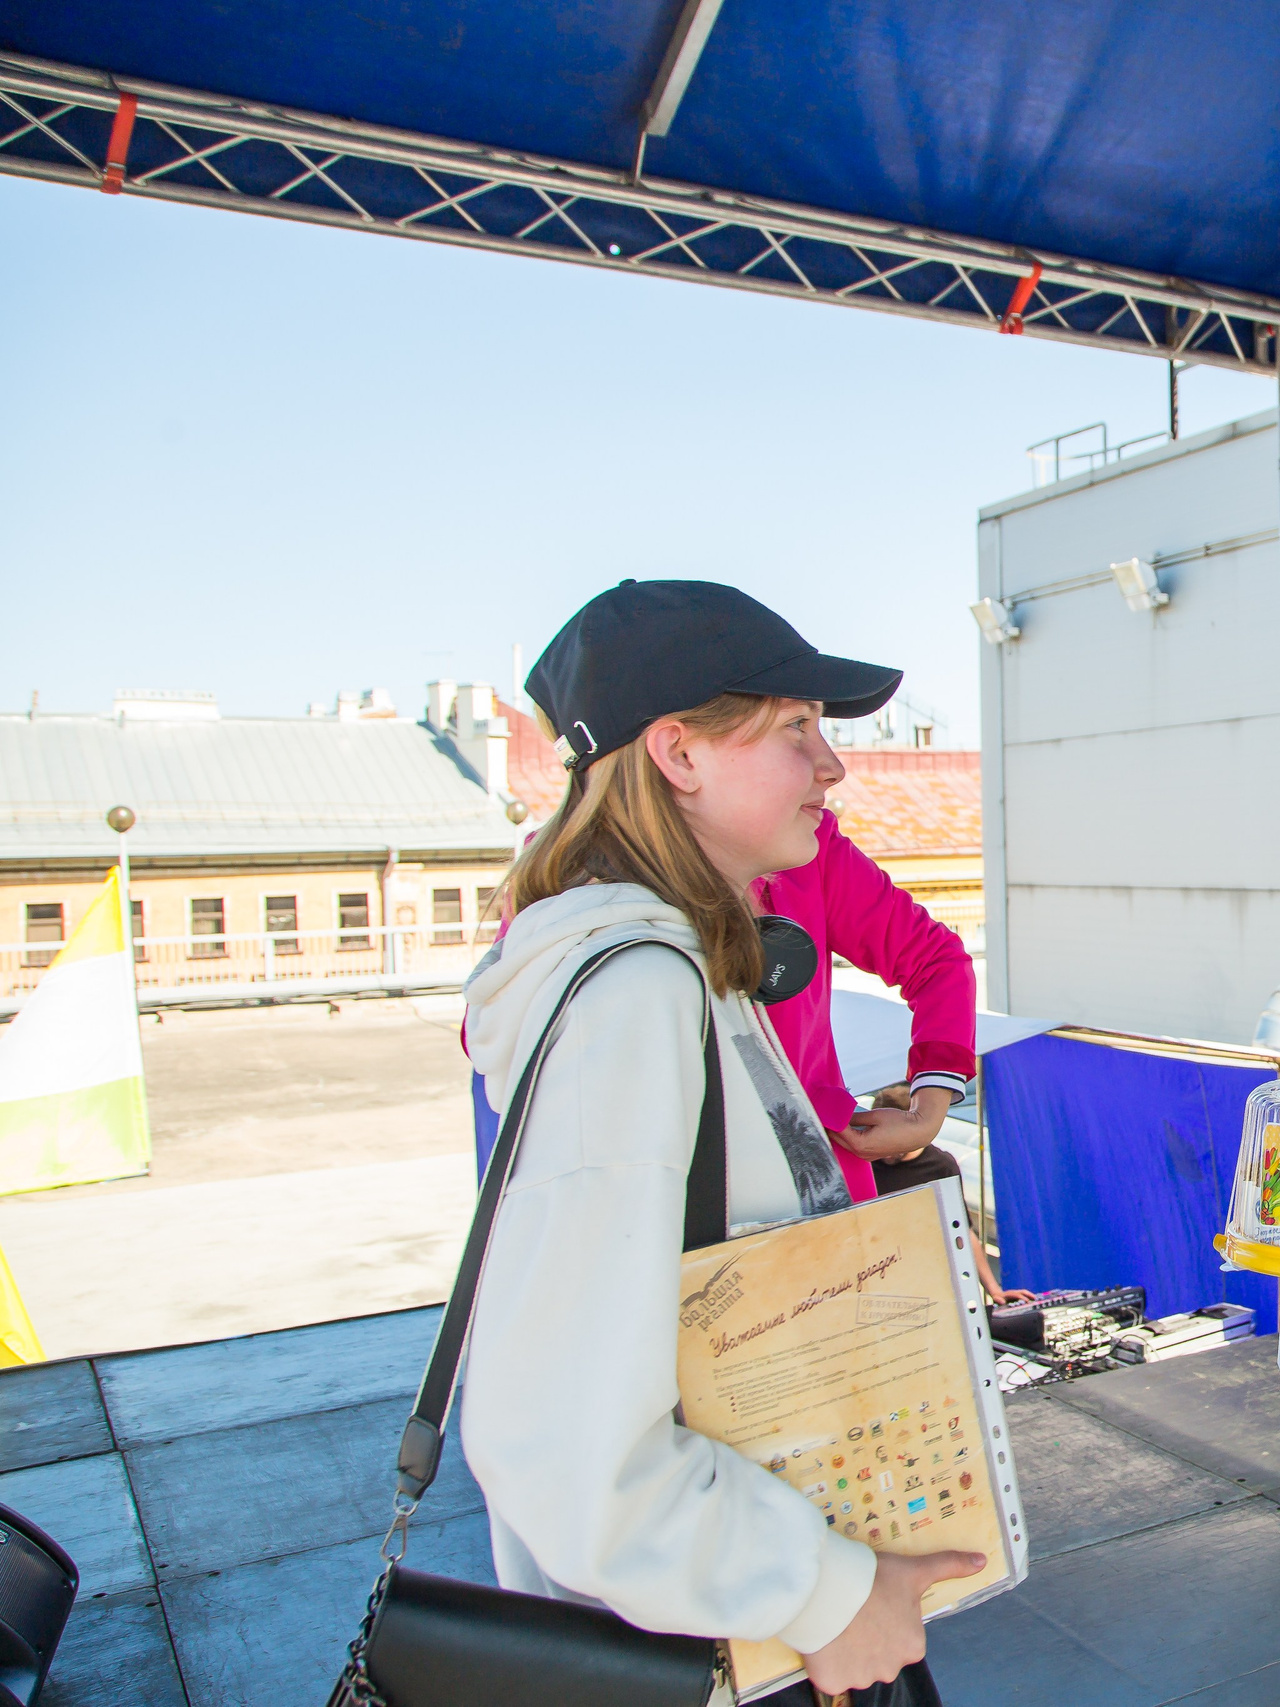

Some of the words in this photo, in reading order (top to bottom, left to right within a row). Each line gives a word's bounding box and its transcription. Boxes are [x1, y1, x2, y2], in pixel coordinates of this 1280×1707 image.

[769, 963, 786, 987] JAYS
[708, 1313, 786, 1358] Уважаемые
[790, 1280, 853, 1319] любители
